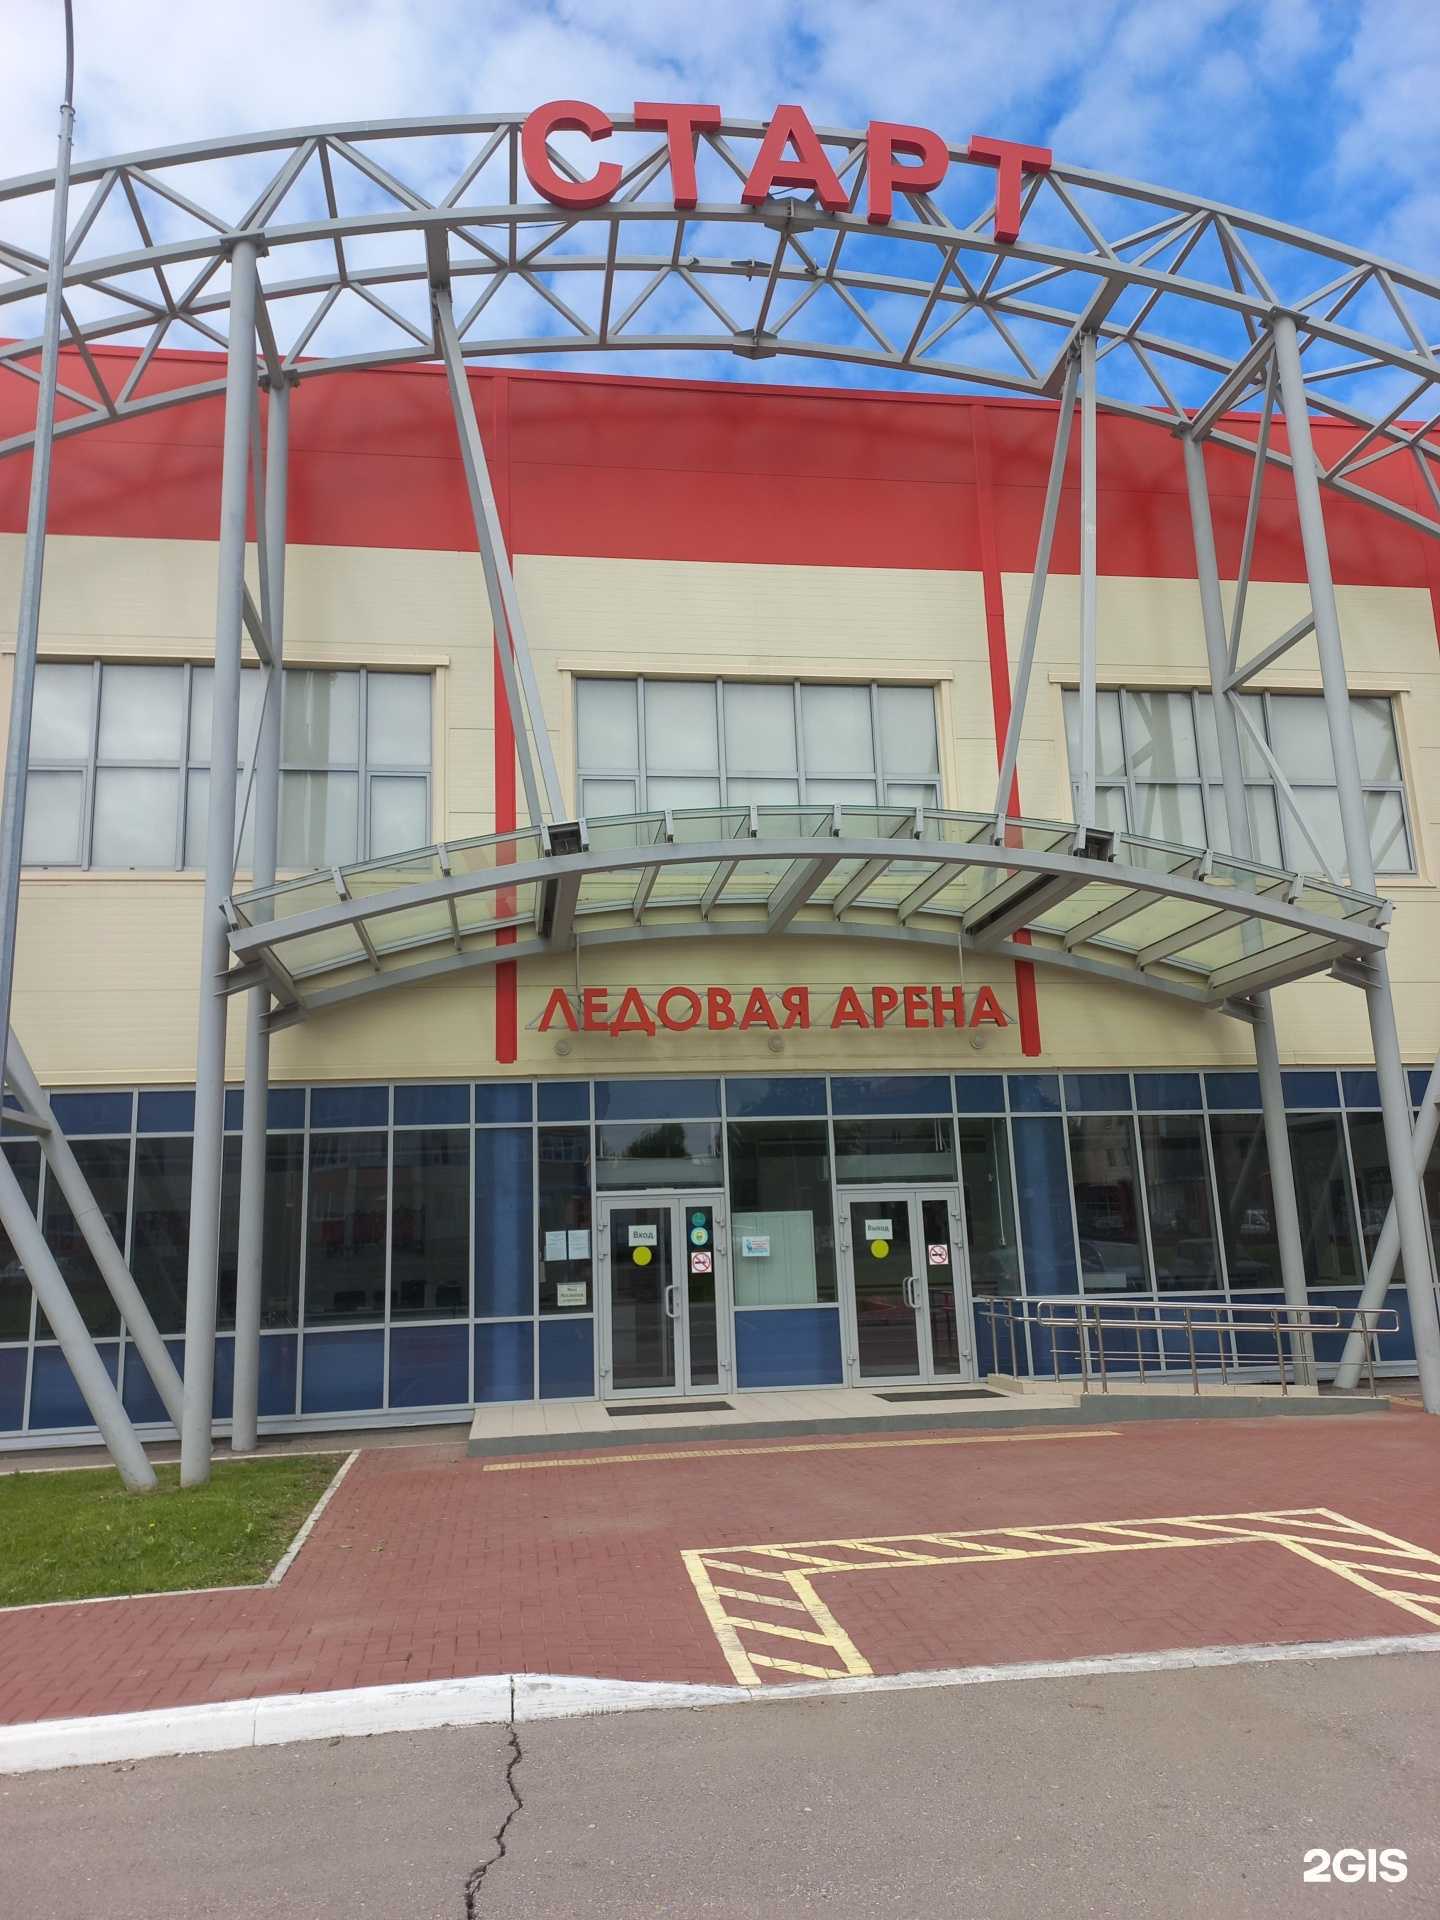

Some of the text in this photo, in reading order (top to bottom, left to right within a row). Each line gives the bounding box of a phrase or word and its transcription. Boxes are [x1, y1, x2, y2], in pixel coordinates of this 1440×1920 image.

[521, 100, 1052, 243] СТАРТ
[538, 986, 1008, 1036] ЛЕДОВАЯ АРЕНА
[633, 1231, 655, 1240] Вход
